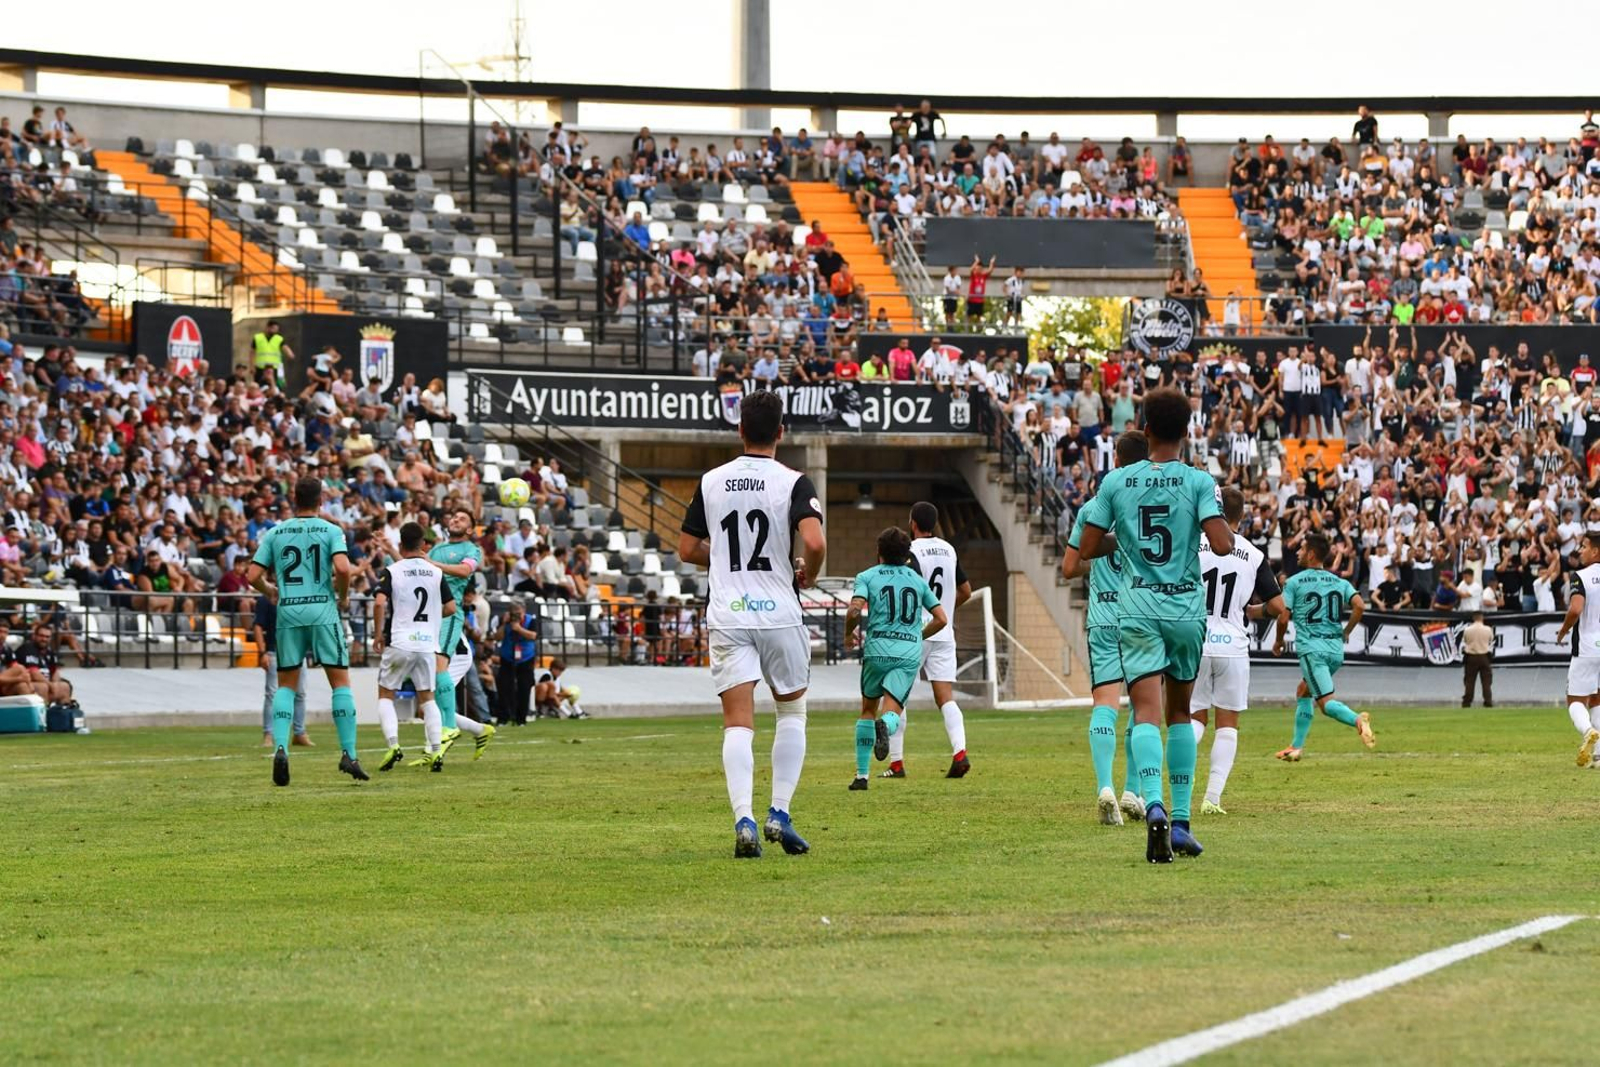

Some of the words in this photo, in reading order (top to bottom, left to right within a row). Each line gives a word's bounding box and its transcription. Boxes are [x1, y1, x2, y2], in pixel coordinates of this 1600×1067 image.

[862, 387, 933, 430] ajoz
[725, 478, 765, 492] SEGOVIA
[1125, 478, 1138, 487] DE
[1145, 477, 1184, 488] CASTRO
[275, 527, 304, 535] ANTONIO
[720, 509, 773, 572] 12
[1138, 505, 1172, 567] 5
[281, 544, 321, 586] 21
[928, 566, 943, 601] 6
[1202, 566, 1238, 619] 11
[413, 586, 428, 622] 2
[880, 585, 919, 627] 10
[1304, 590, 1343, 626] 20
[1169, 774, 1189, 785] 909
